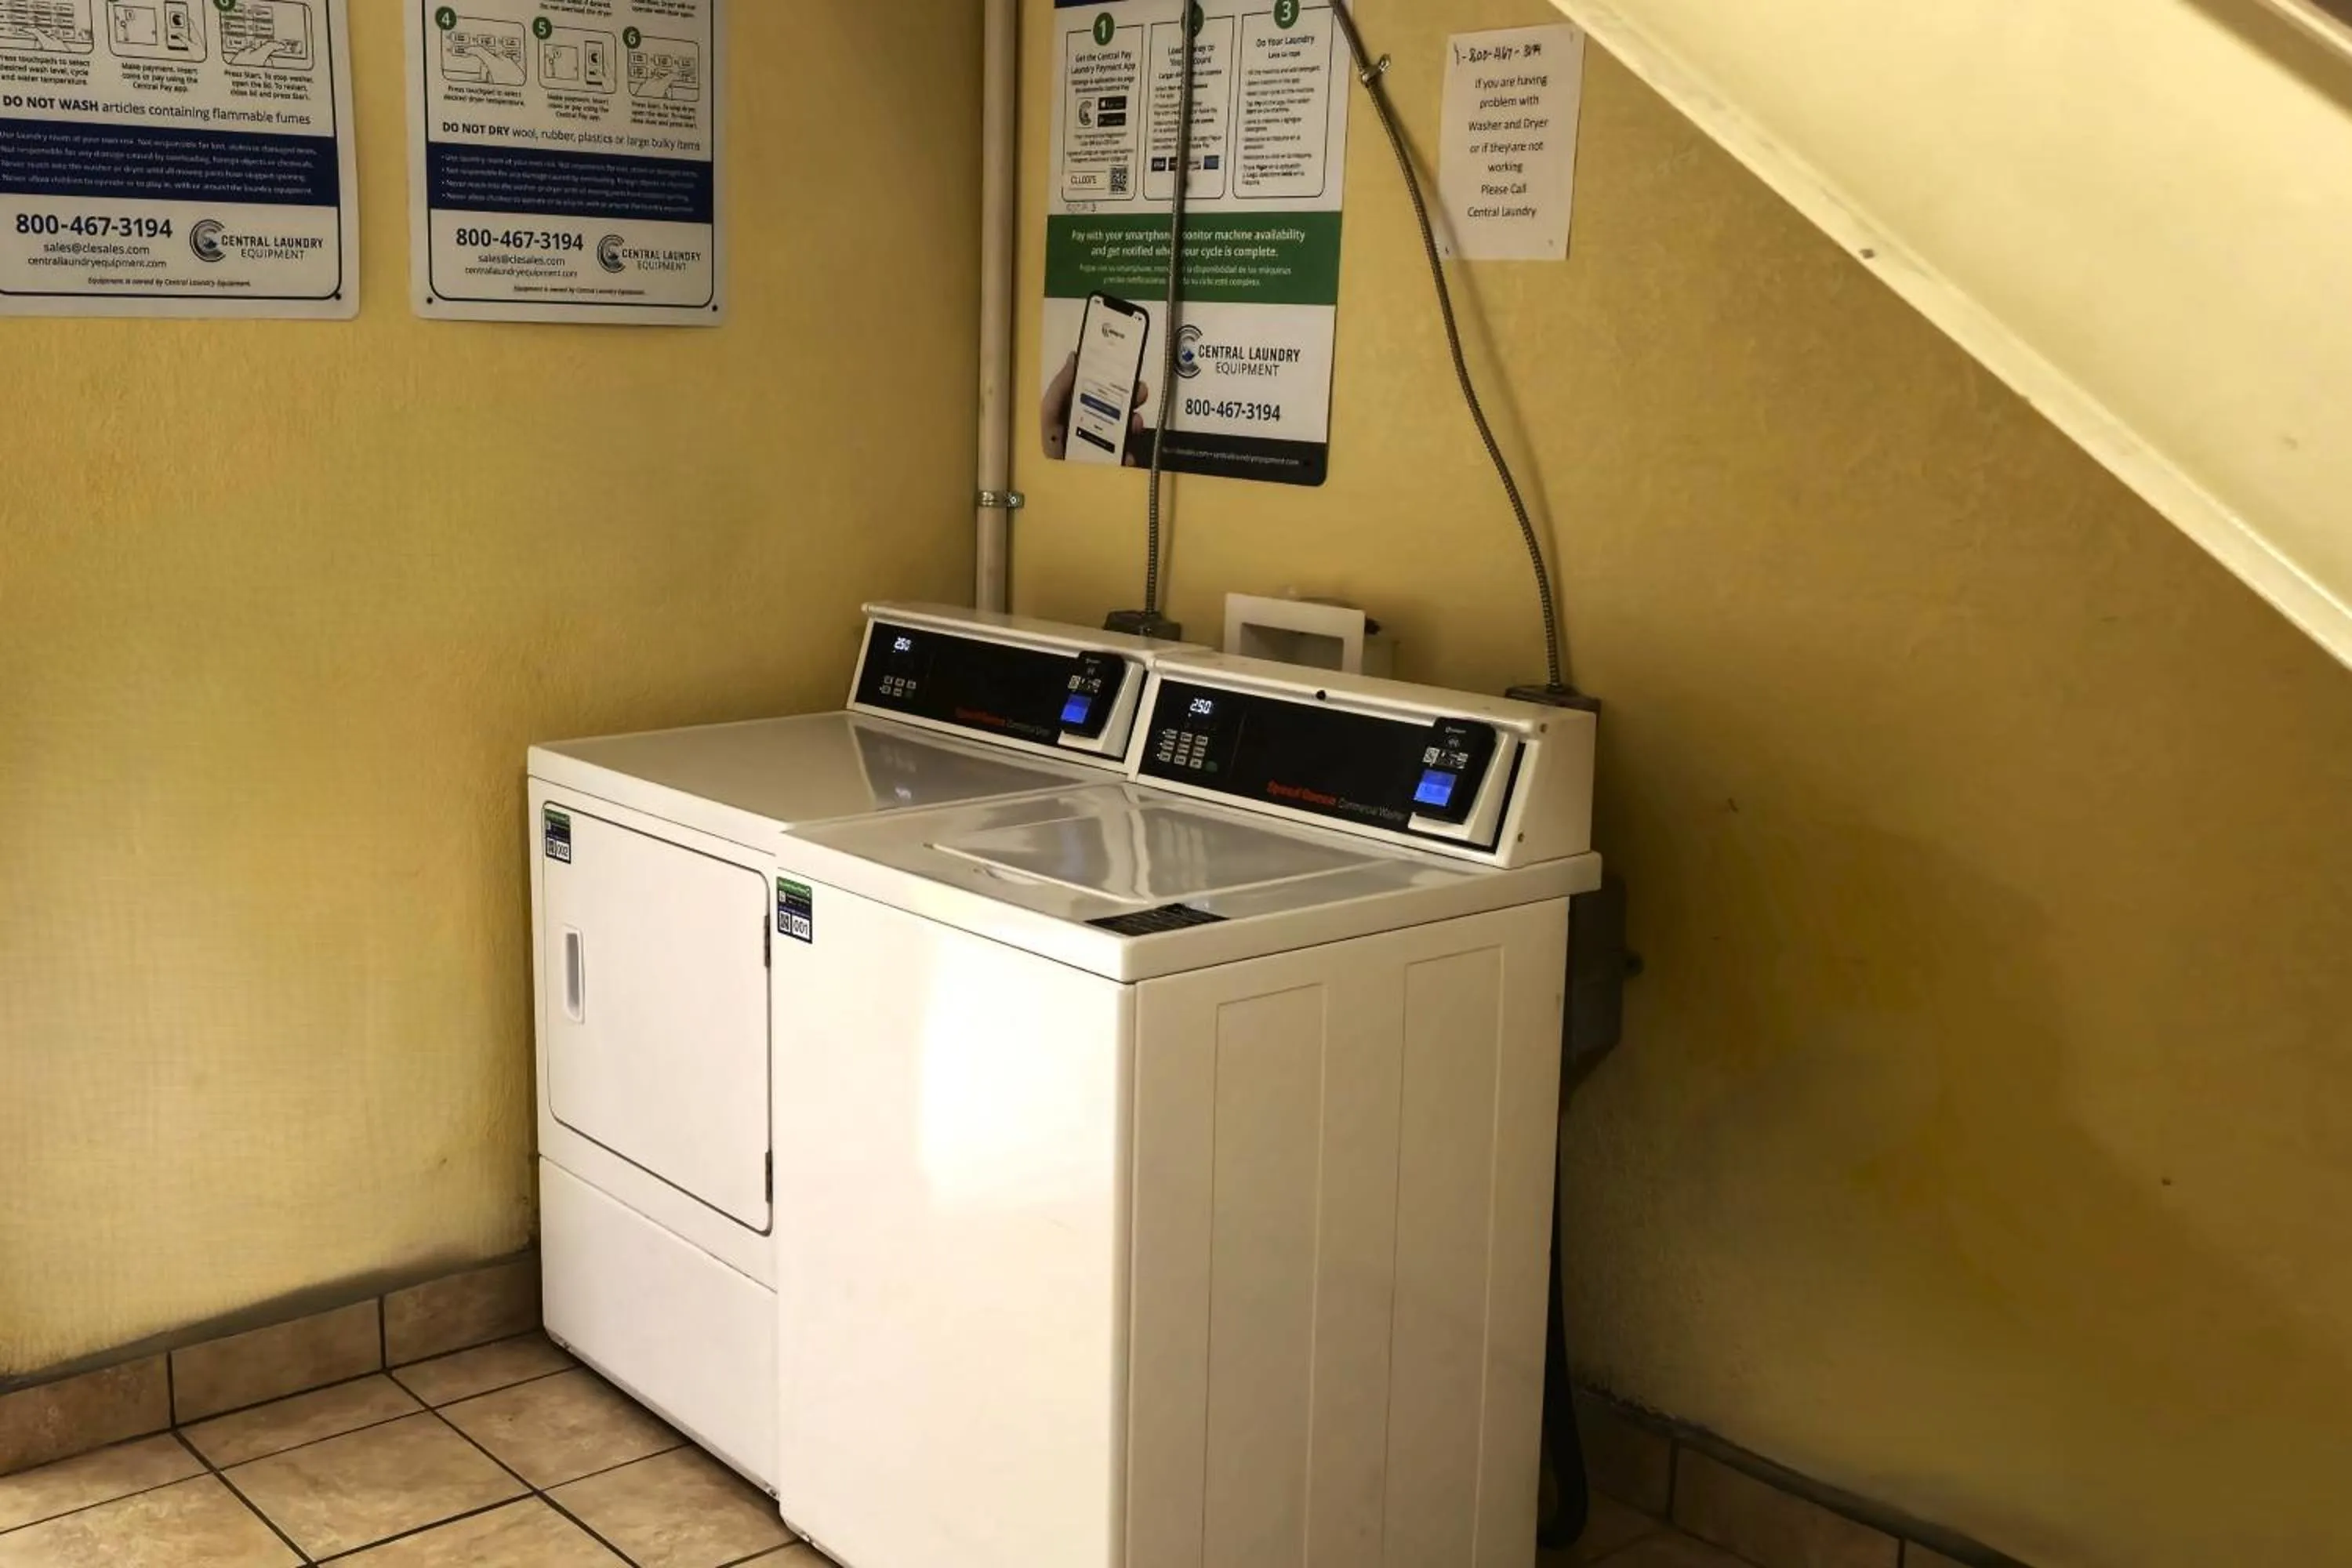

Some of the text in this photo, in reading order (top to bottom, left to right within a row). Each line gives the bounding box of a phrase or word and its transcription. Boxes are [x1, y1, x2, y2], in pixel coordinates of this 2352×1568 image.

[1280, 2, 1292, 21] 3
[441, 12, 451, 26] 4
[539, 21, 546, 34] 5
[1098, 20, 1106, 40] 1
[627, 33, 636, 45] 6
[1256, 35, 1315, 47] Do Your Laundry
[1075, 53, 1085, 63] Get
[1098, 51, 1120, 61] Central
[1121, 50, 1132, 60] Pay
[1071, 63, 1136, 74] Laundry Payment App
[1483, 78, 1498, 92] you
[1500, 78, 1515, 87] are
[1517, 74, 1548, 87] having
[1479, 94, 1539, 109] problem with
[2, 95, 310, 124] DO NOT WASH articles containing flammable fumes
[1468, 118, 1549, 132] Washer and Dryer
[442, 122, 700, 151] DO NOT DRY wool, rubber, plastics or large bulky items
[1469, 141, 1544, 155] or if they are not
[1487, 160, 1523, 173] working
[1481, 182, 1527, 195] Please Call
[1467, 205, 1537, 220] Central Laundry
[16, 213, 173, 238] 800-467-3194
[221, 234, 324, 249] CENTRAL LAUNDRY
[456, 228, 584, 251] 800-467-3194
[1071, 230, 1084, 243] Pay
[1086, 230, 1103, 241] with
[1105, 230, 1123, 243] your
[1125, 230, 1172, 242] smartphon
[1214, 229, 1254, 241] machine
[1254, 228, 1305, 243] availability
[43, 242, 150, 256] sales@clesales.com
[241, 249, 305, 260] EQUIPMENT
[622, 249, 702, 261] CENTRAL LAUNDRY
[1091, 246, 1106, 256] and
[1106, 246, 1120, 258] get
[1122, 245, 1153, 256] notified
[1155, 246, 1171, 256] whe
[1200, 246, 1223, 259] cycle
[1224, 245, 1232, 256] is
[1233, 245, 1279, 259] complete.
[27, 257, 167, 269] centrallaundryequipment.com
[477, 254, 565, 267] sales@clesales.com
[637, 260, 687, 270] EQUIPMENT
[465, 266, 578, 278] centrallaundryequipment.com
[1198, 344, 1301, 363] CENTRAL LAUNDRY
[1216, 362, 1280, 376] EQUIPMENT
[1185, 398, 1281, 422] 800-467-3194
